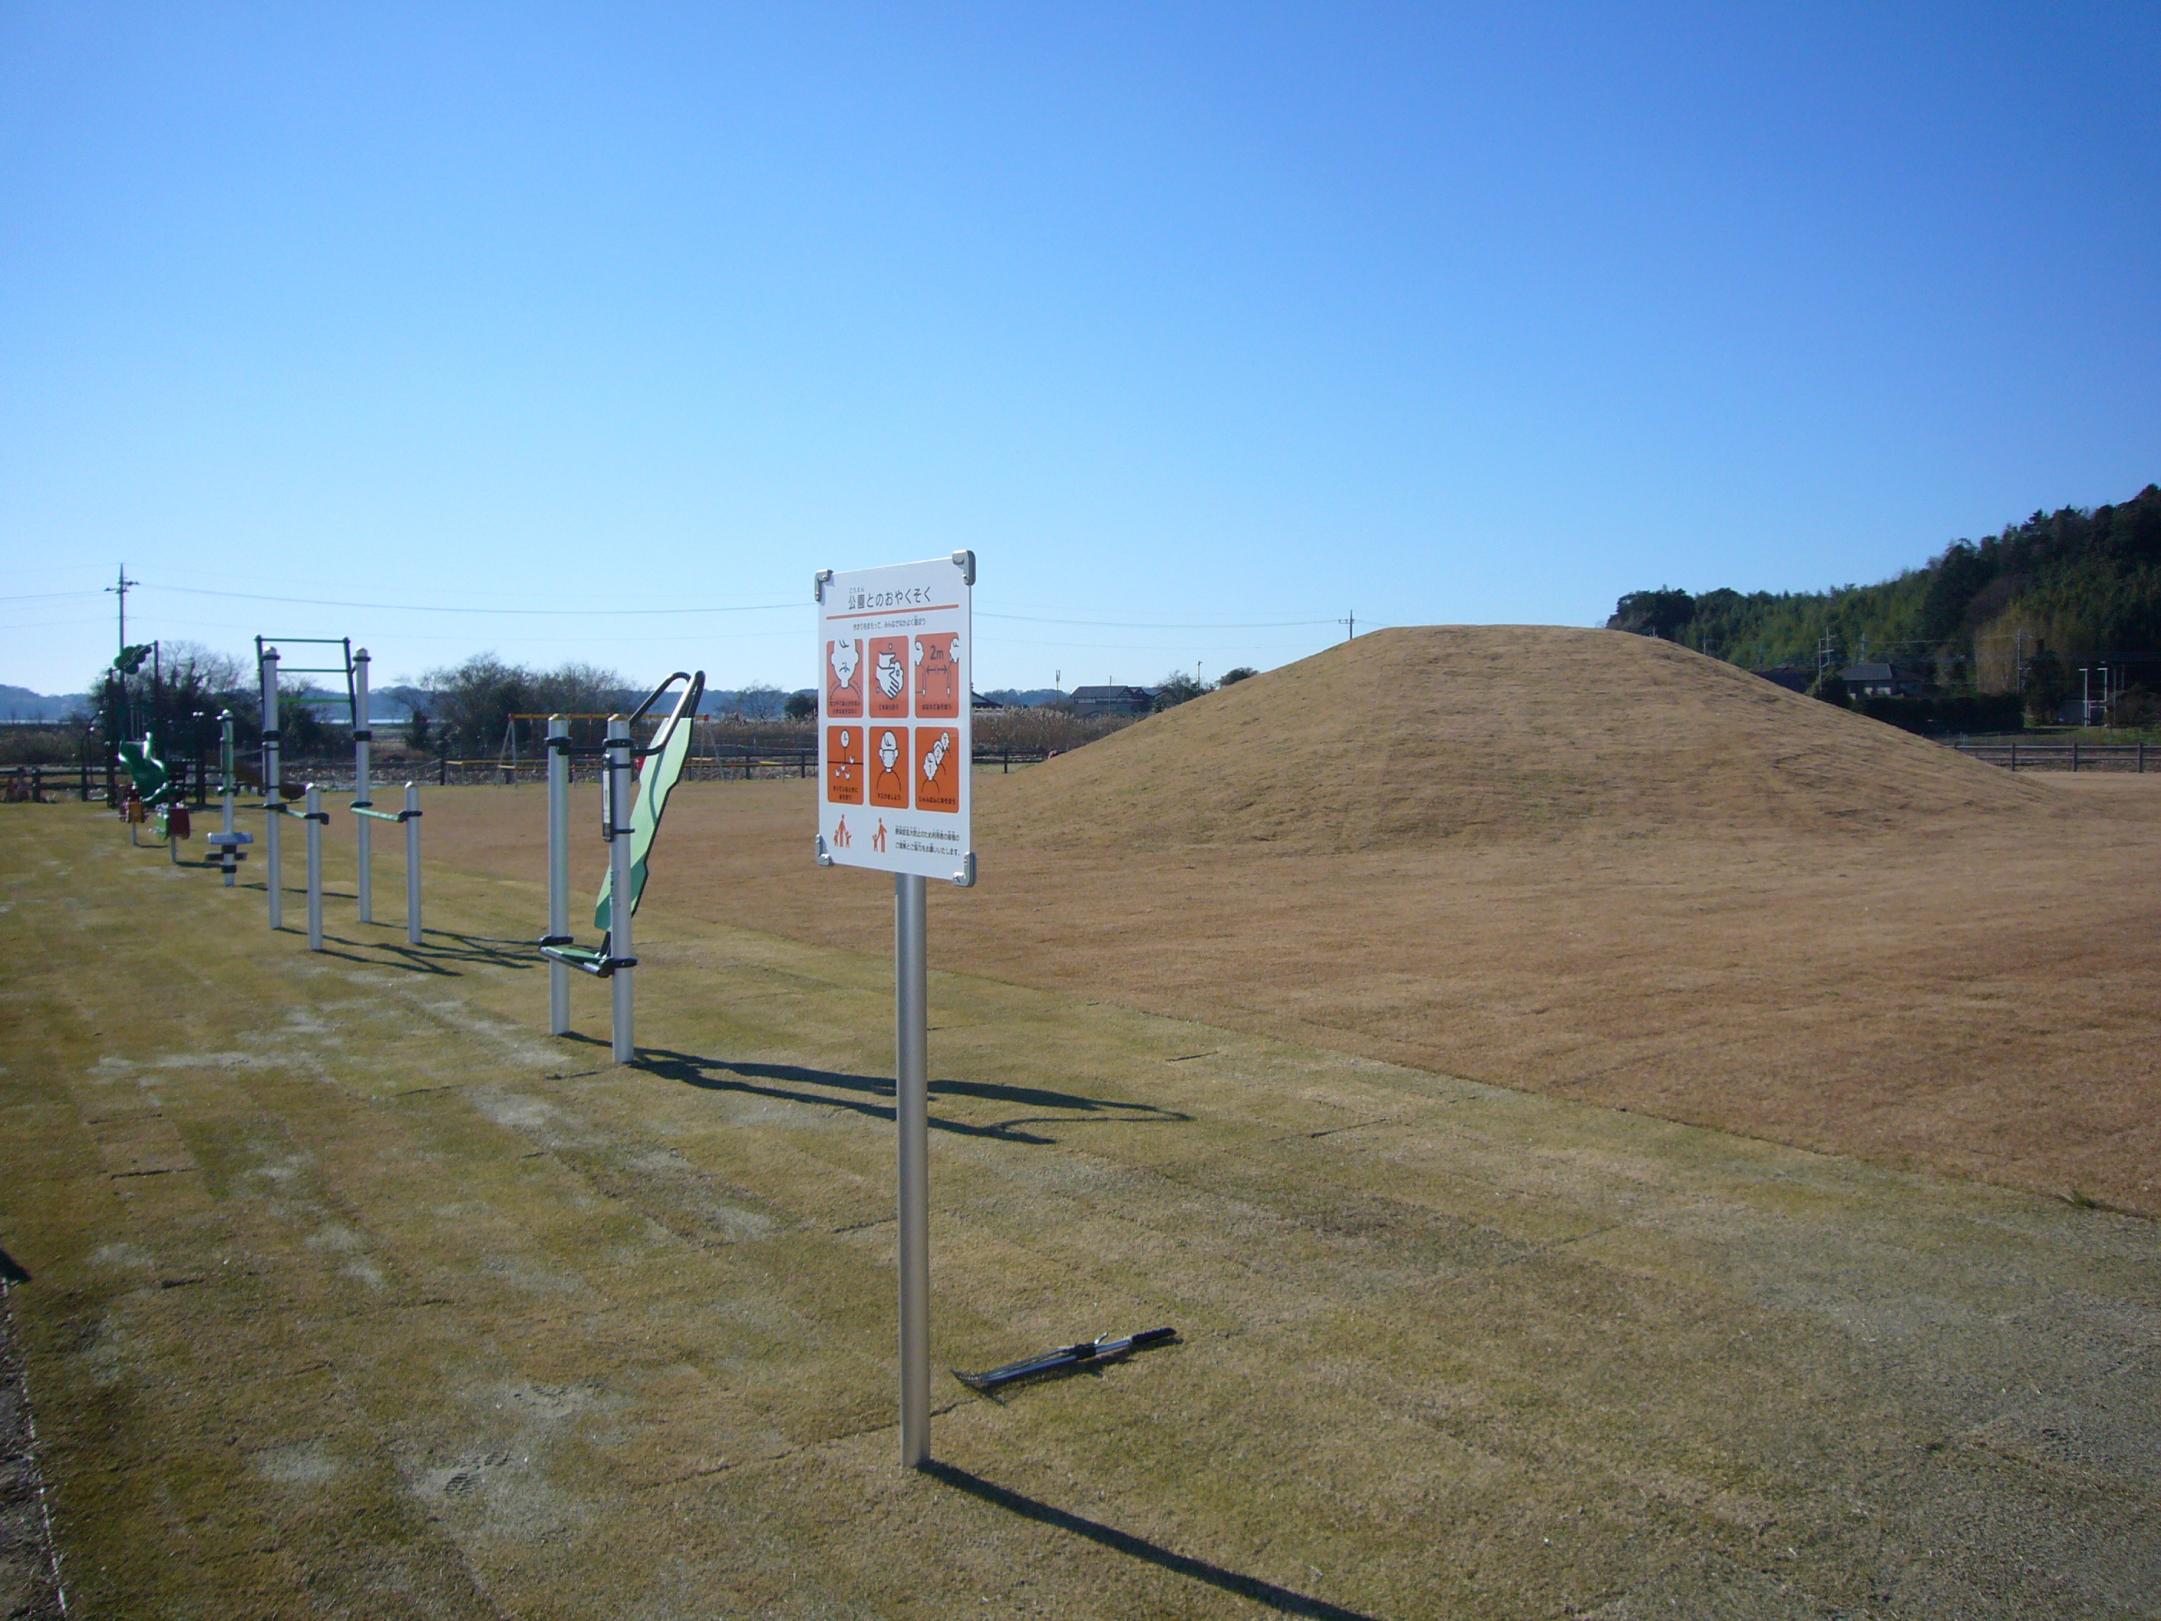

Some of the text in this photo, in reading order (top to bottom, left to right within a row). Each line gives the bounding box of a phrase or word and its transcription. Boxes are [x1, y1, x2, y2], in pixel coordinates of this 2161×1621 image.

[848, 586, 931, 610] 公園とのおやくそく
[930, 645, 944, 660] 2m
